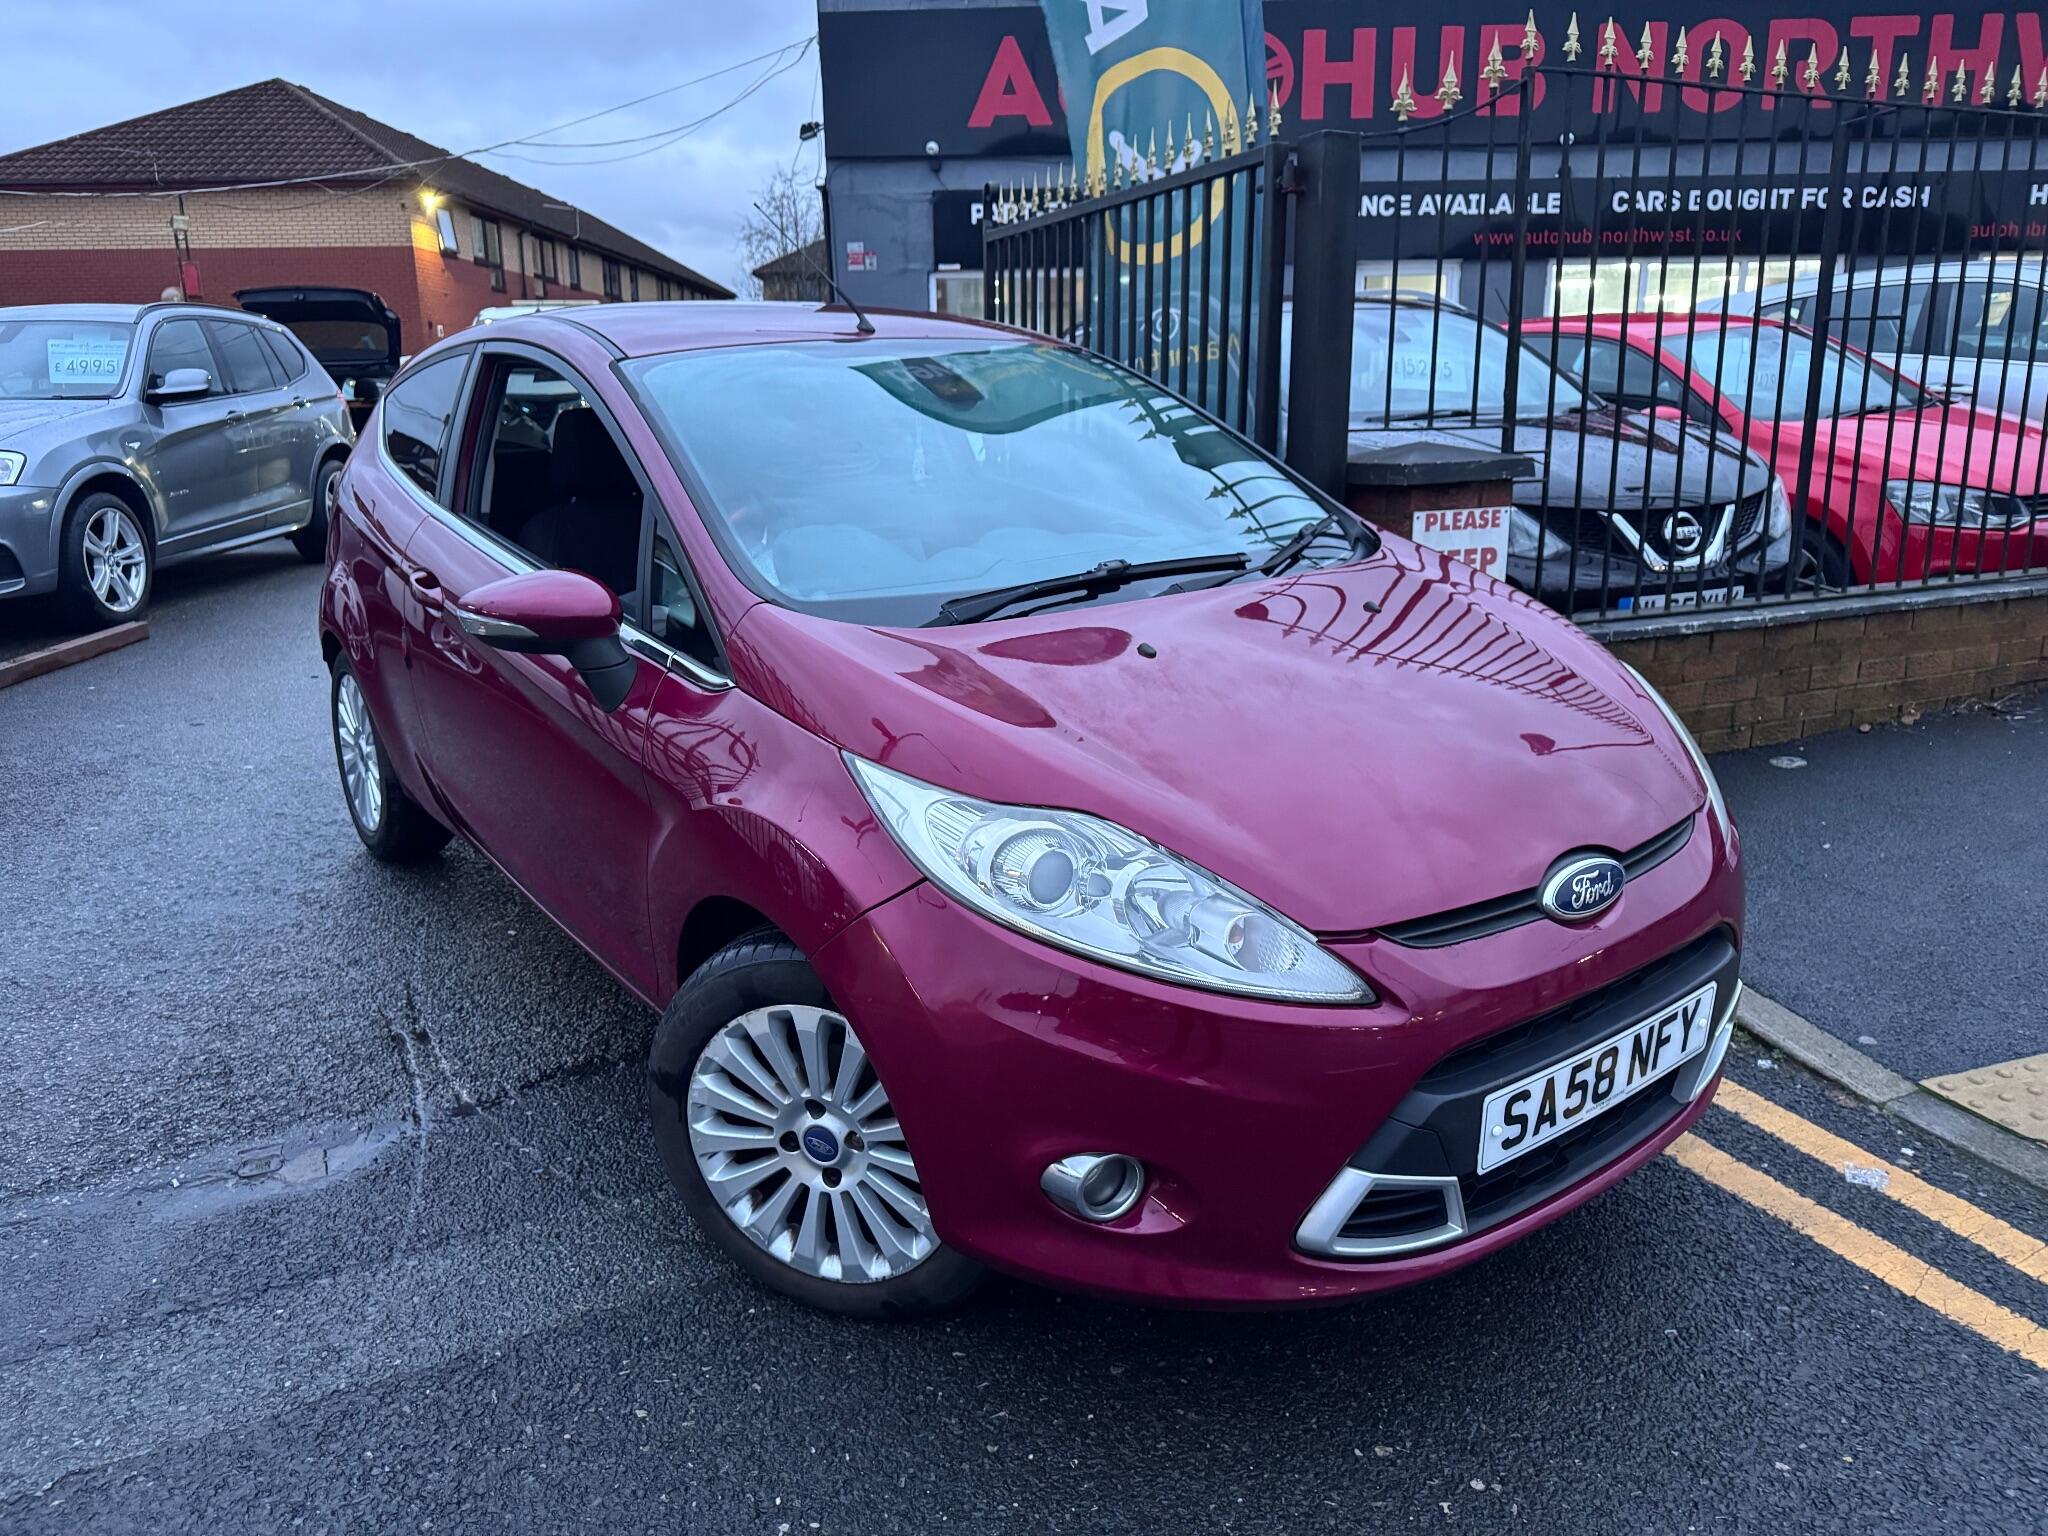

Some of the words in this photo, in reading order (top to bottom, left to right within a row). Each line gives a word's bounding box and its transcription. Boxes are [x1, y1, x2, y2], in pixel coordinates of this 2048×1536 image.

[1358, 194, 1412, 216] NCE
[1418, 193, 1561, 216] AVAILALE
[1612, 189, 1682, 213] CARS
[1862, 184, 1931, 209] CASH
[1473, 227, 1742, 246] wwwautohubnorthwst.o.uk
[1424, 509, 1501, 532] PLEASE
[1443, 547, 1498, 573] EP
[1571, 870, 1614, 909] Ford
[1501, 1045, 1620, 1151] SA58
[1626, 997, 1703, 1087] NFY
